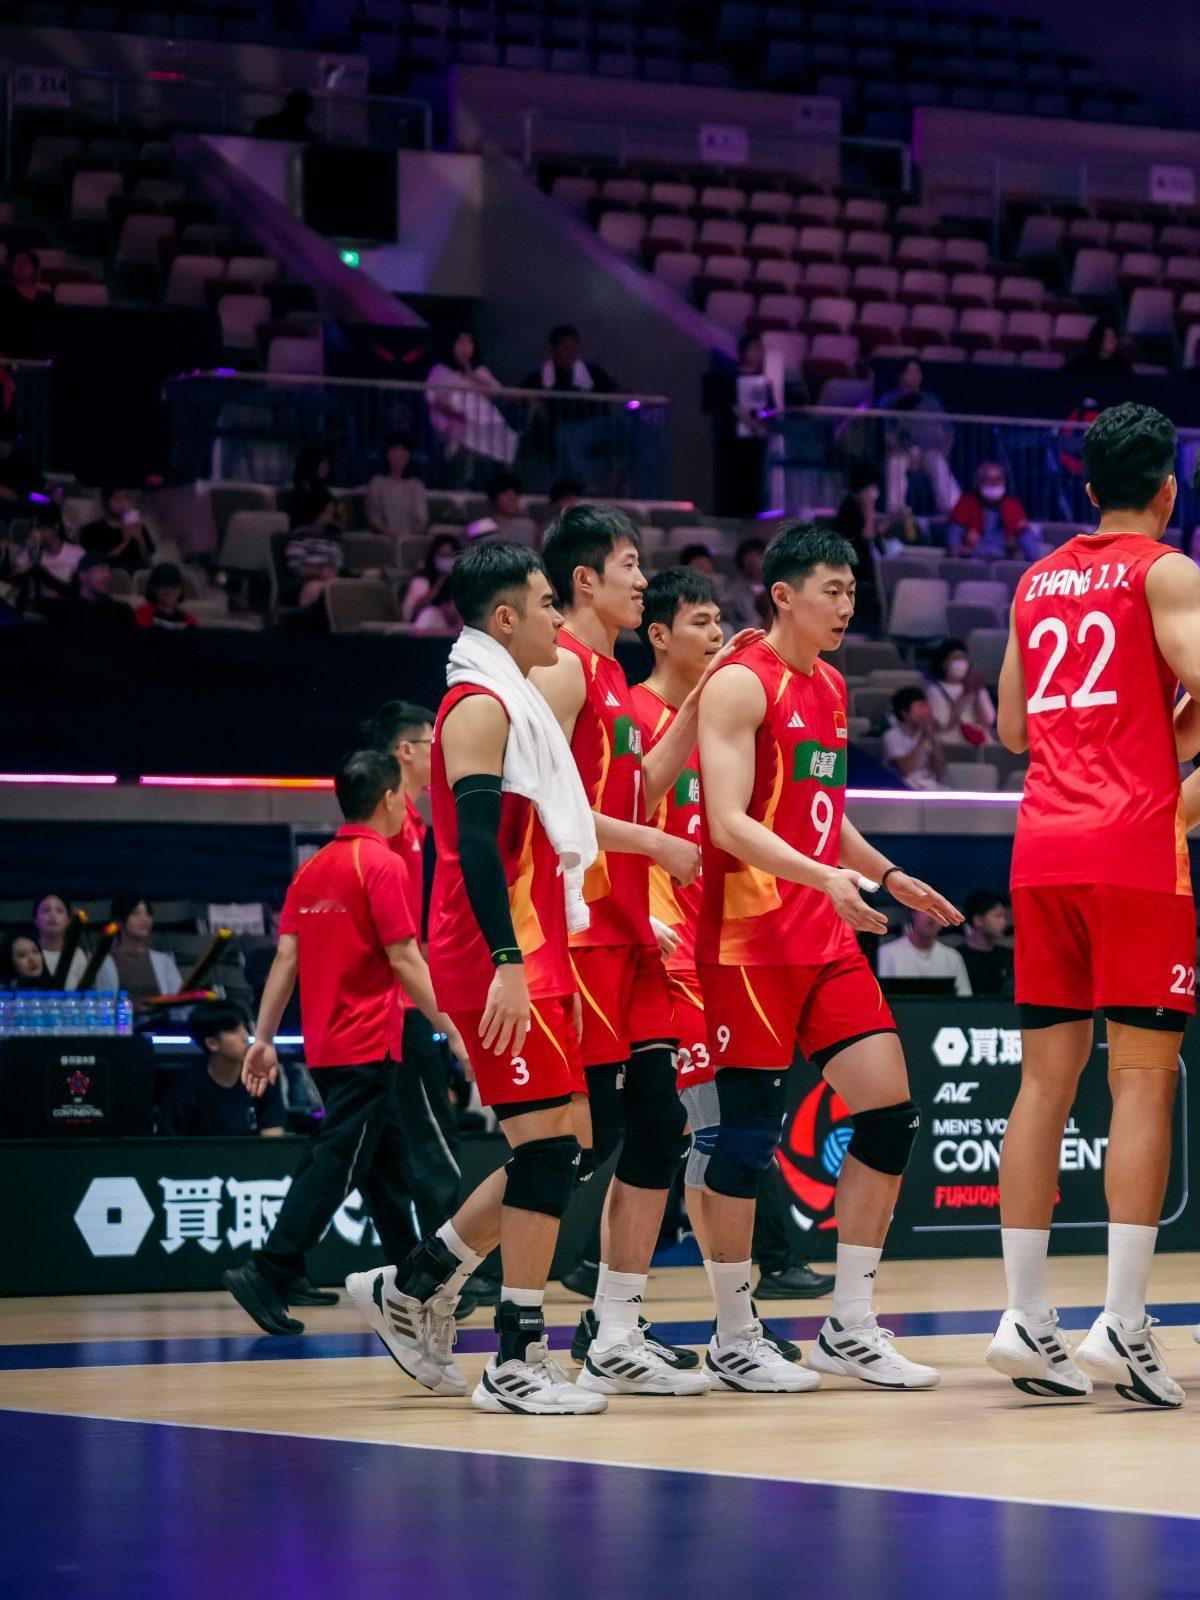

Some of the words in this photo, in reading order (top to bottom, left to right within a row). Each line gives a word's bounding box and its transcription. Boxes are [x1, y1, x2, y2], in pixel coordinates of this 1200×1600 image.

[1024, 567, 1093, 602] ZHANG
[1094, 562, 1129, 591] J.Y.
[1027, 610, 1118, 714] 22
[810, 790, 834, 857] 9
[1169, 963, 1196, 996] 22
[717, 1025, 731, 1053] 9
[968, 1027, 1023, 1066] 買取
[510, 1056, 530, 1086] 3
[678, 1042, 710, 1075] 23
[932, 1118, 982, 1136] MEN'S
[934, 1185, 1001, 1209] FUKUOK
